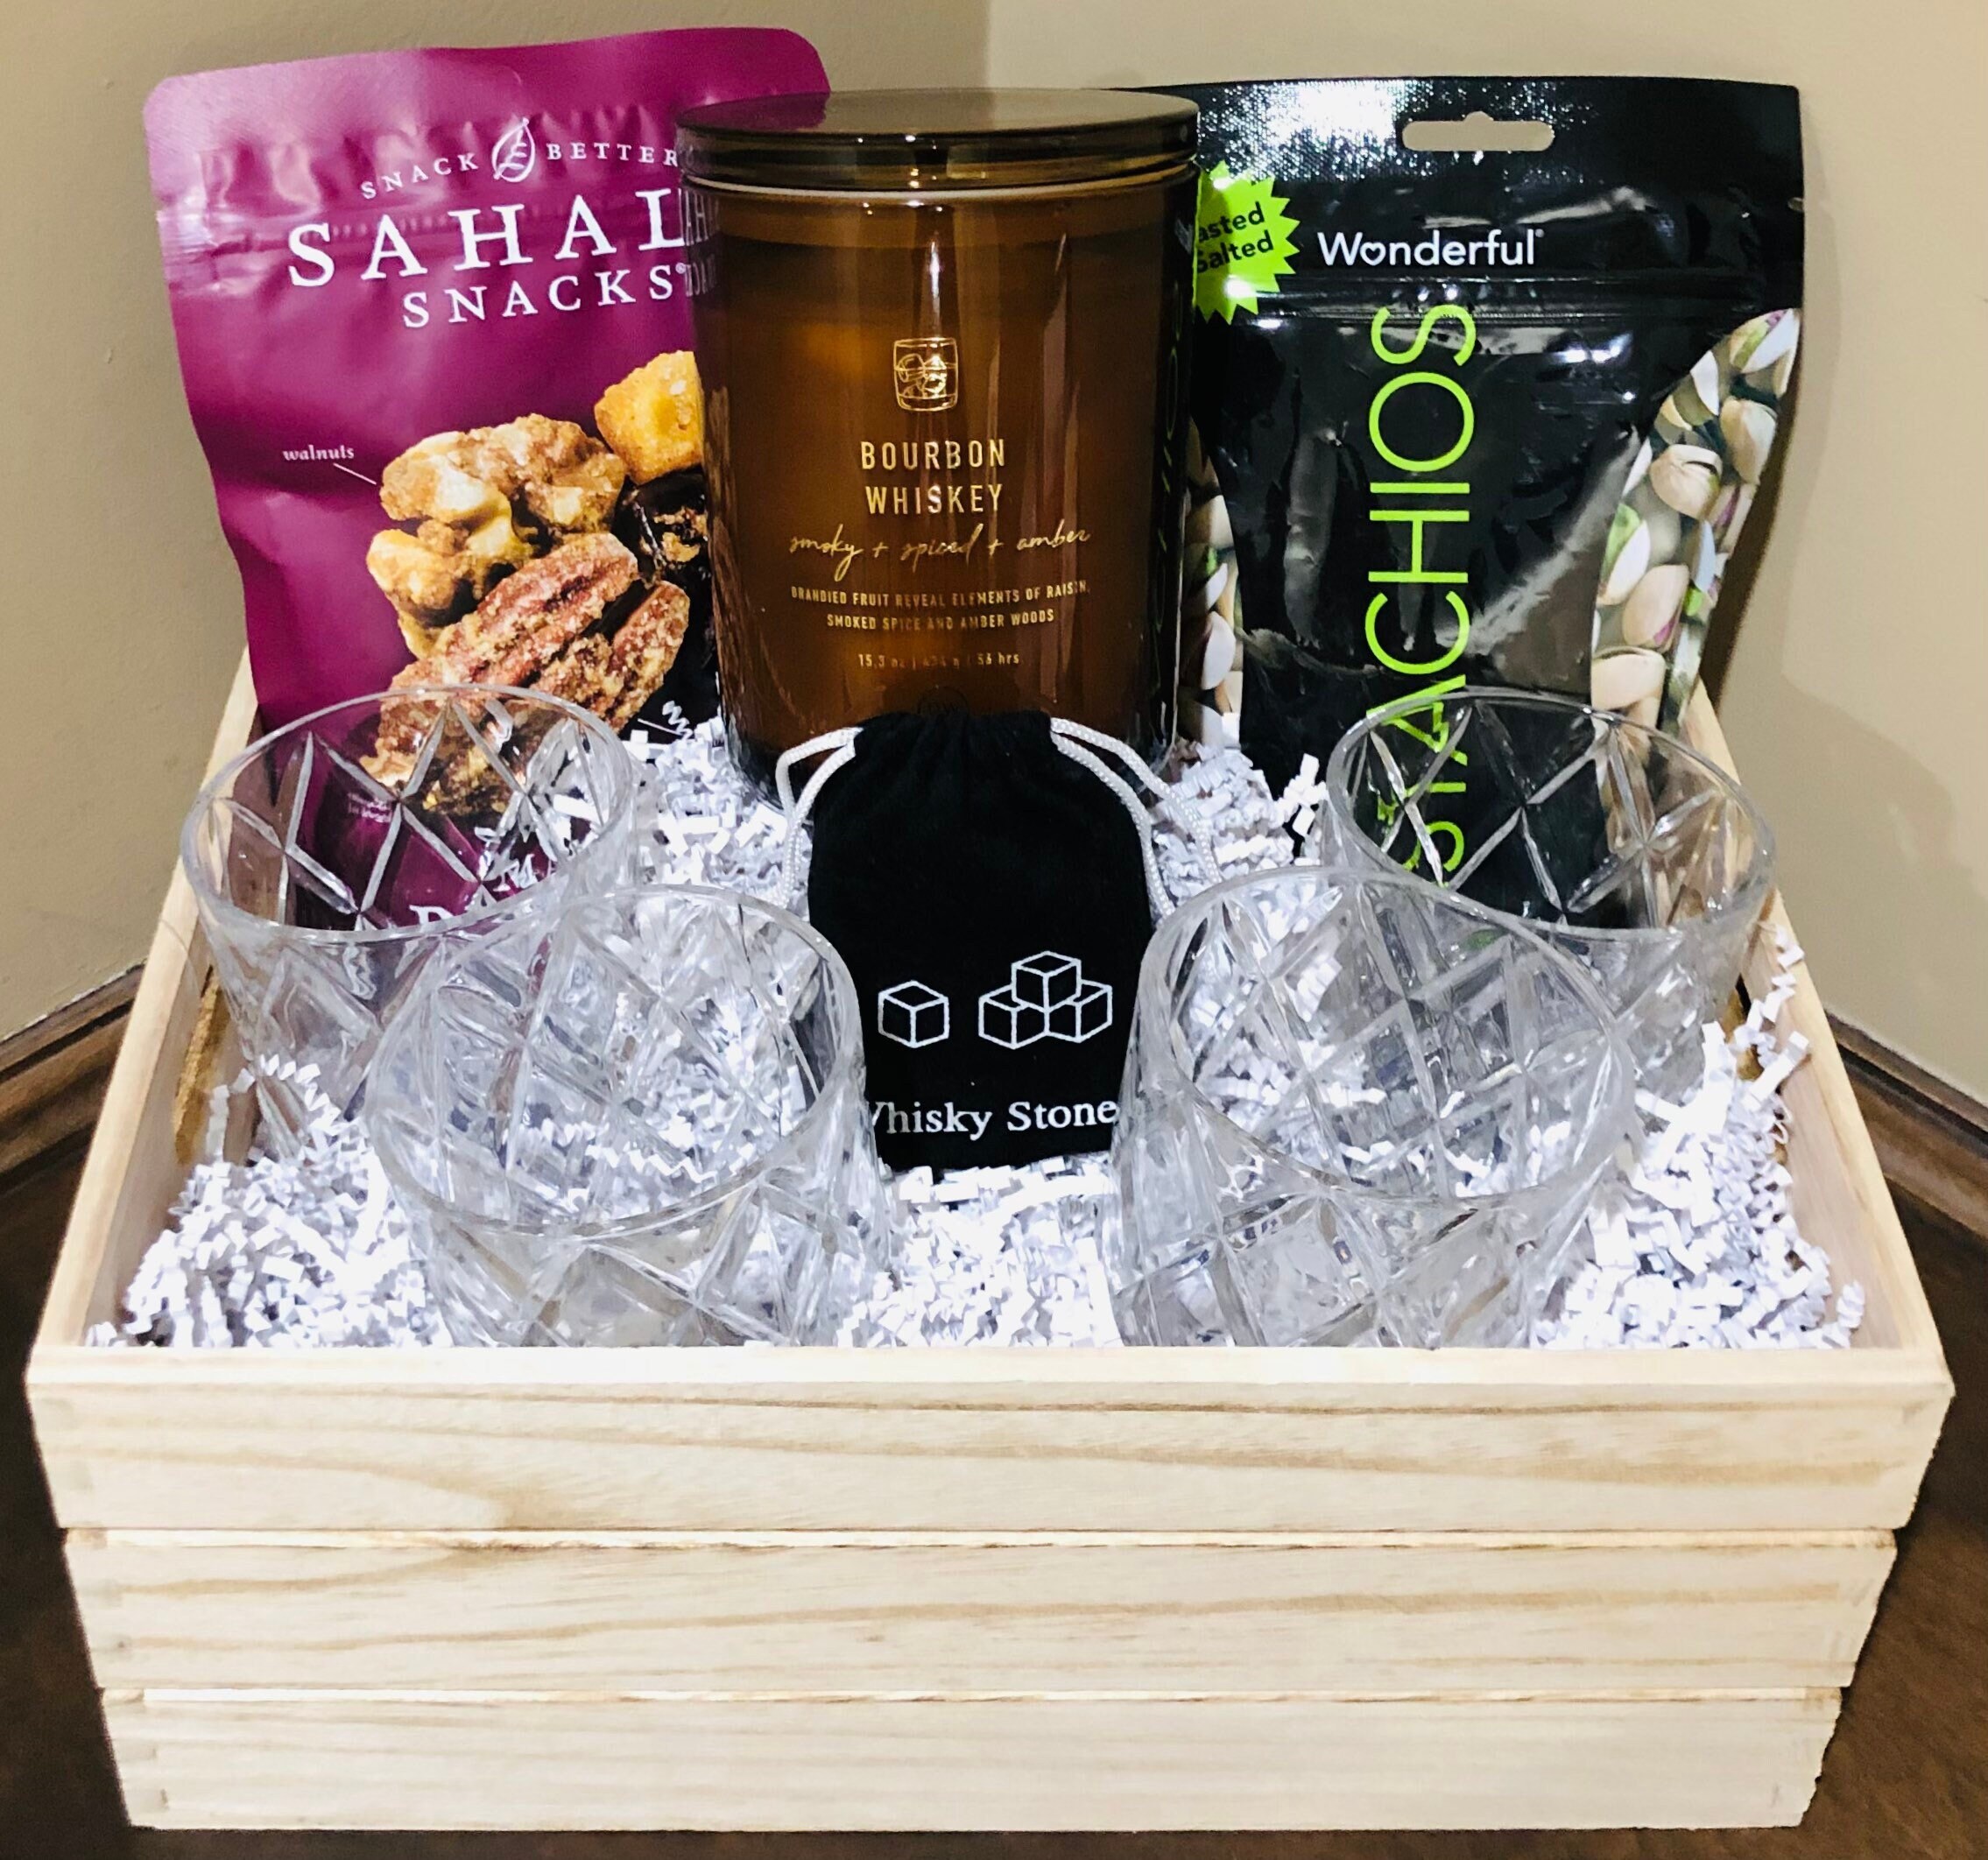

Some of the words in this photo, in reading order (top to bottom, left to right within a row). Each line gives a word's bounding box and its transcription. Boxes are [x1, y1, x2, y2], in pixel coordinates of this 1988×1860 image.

[360, 152, 479, 200] SNACK
[546, 142, 679, 168] BETTER
[286, 187, 686, 288] SAHAL
[1198, 201, 1265, 243] asted
[1317, 228, 1535, 267] Wonderful
[282, 444, 355, 461] walnuts
[860, 439, 1005, 471] BOURBON
[865, 483, 1004, 515] WHISKEY
[789, 523, 864, 581] smoky
[900, 522, 983, 574] spiced
[1016, 518, 1090, 552] amber
[791, 585, 847, 604] BRANDIED
[852, 592, 889, 607] FRUIT
[895, 593, 946, 608] REVEAL
[952, 589, 1020, 607] ELEMENTS
[1025, 586, 1040, 601] OF
[1365, 304, 1476, 876] STACHIOS
[827, 614, 876, 630] SMOKED
[882, 616, 920, 631] SPICE
[927, 616, 953, 630] AND
[960, 614, 1005, 630] AMBER
[1011, 608, 1054, 626] WOODS
[998, 652, 1019, 666] hrs
[1006, 1100, 1121, 1132] Stone
